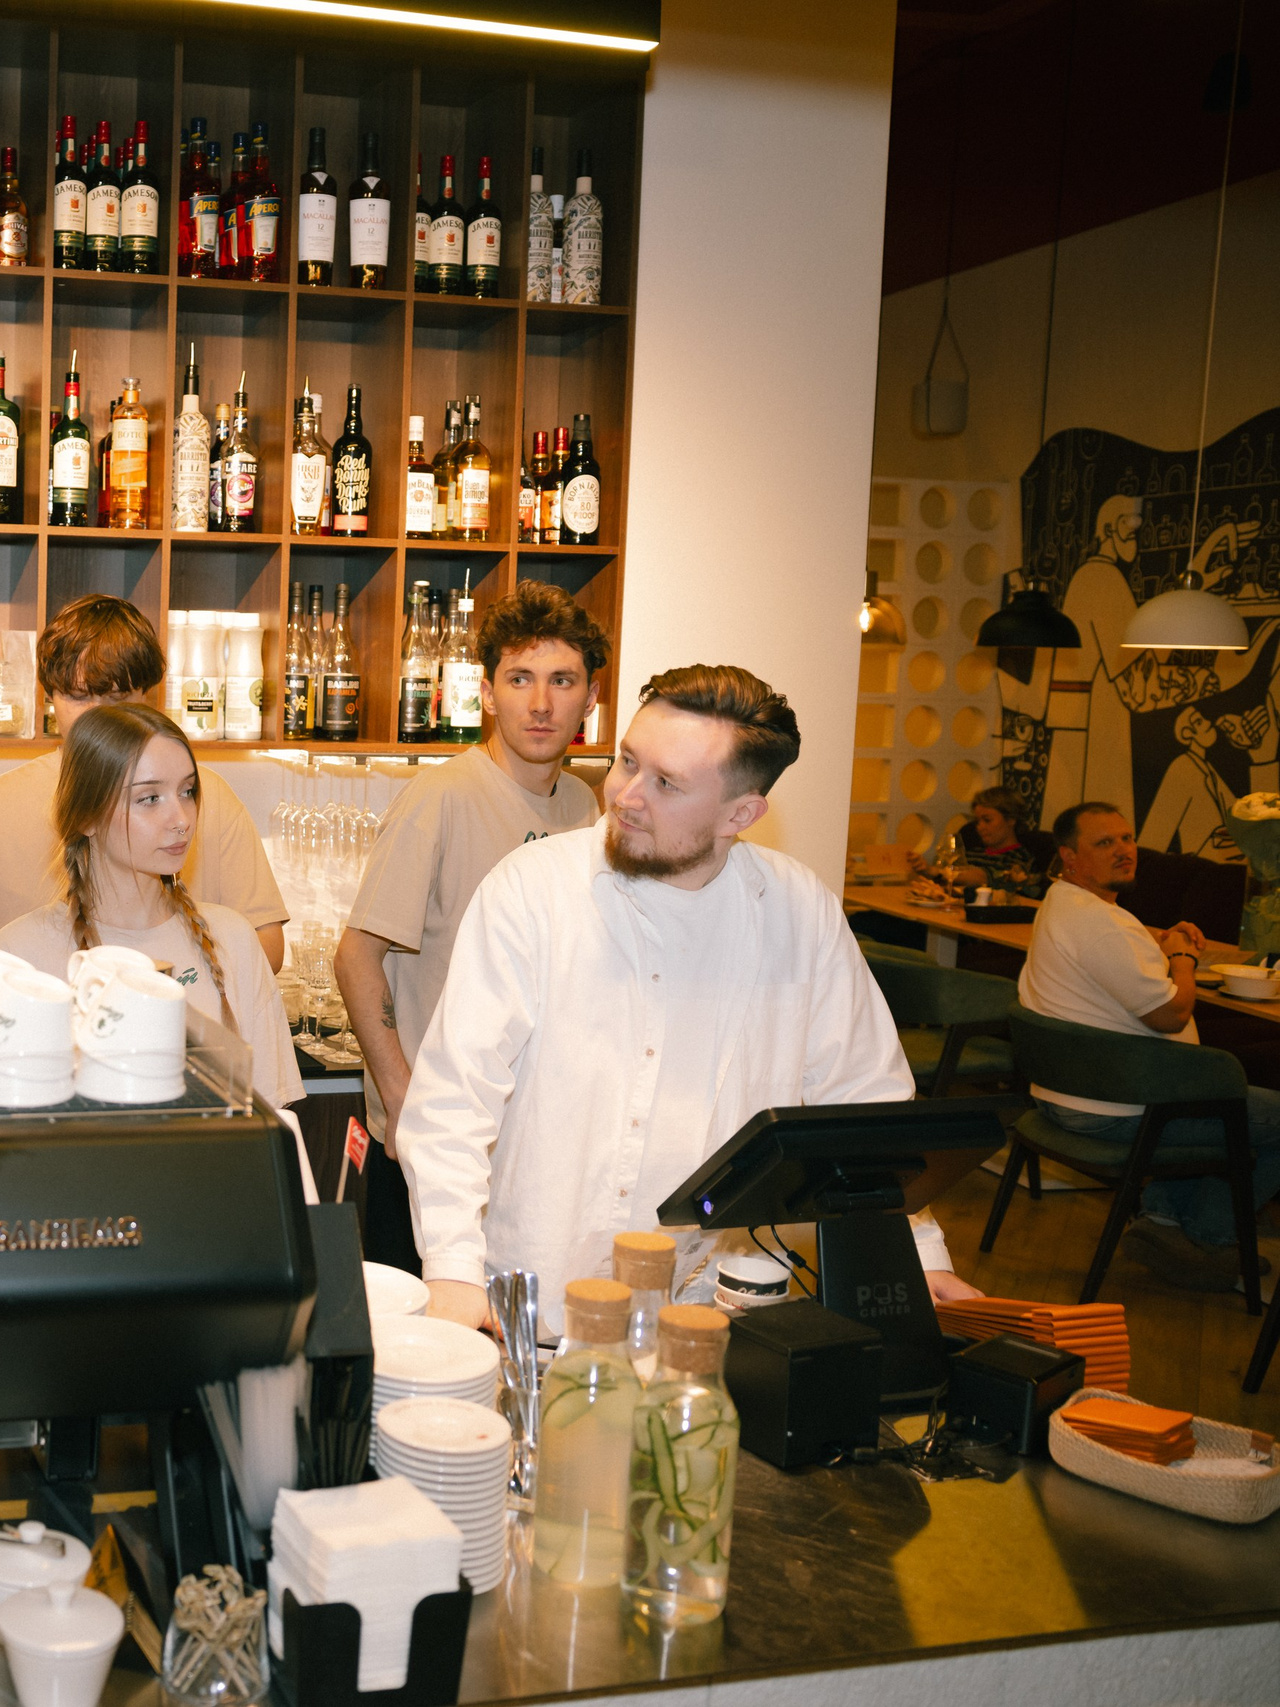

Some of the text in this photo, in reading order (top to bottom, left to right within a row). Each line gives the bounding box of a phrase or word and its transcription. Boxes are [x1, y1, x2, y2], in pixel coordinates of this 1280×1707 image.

[55, 184, 86, 196] JAMESO
[194, 200, 219, 214] APER
[3, 222, 27, 232] CHIVAS
[57, 441, 88, 453] JAMESO
[338, 453, 367, 471] Red
[334, 467, 370, 487] Bonny
[335, 481, 370, 499] Dark
[338, 497, 368, 513] Rum
[580, 501, 592, 511] 80
[860, 1304, 911, 1318] CENTER
